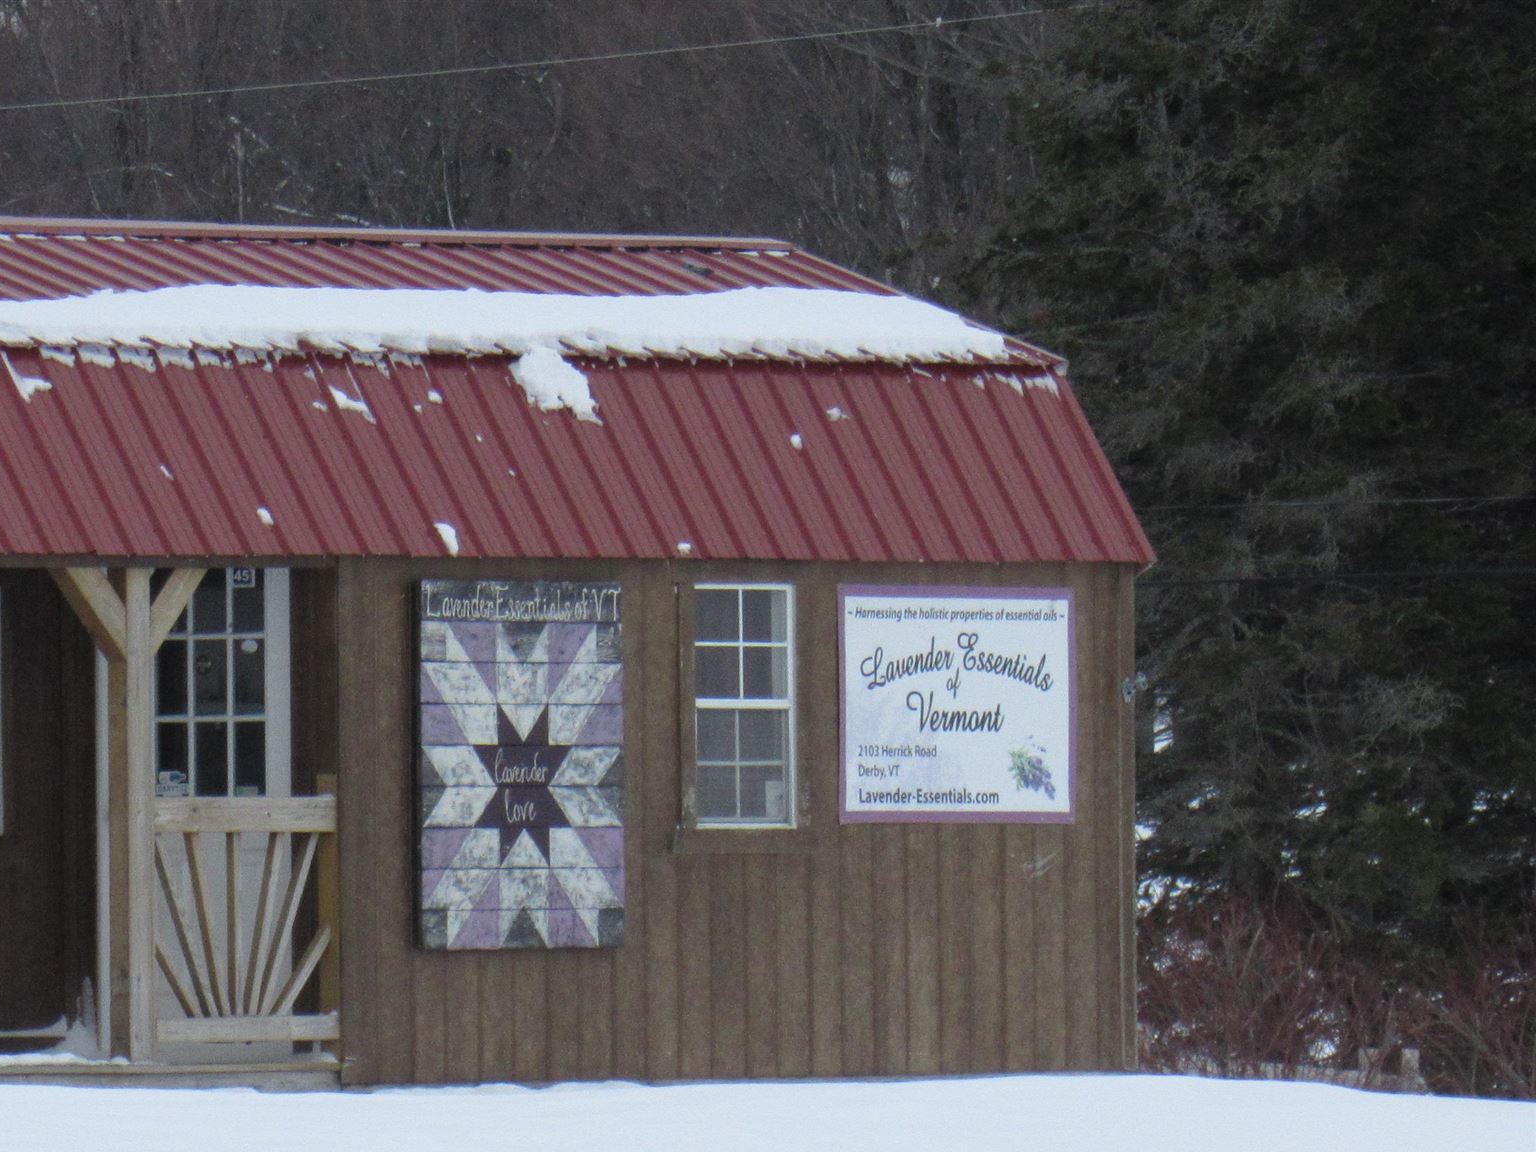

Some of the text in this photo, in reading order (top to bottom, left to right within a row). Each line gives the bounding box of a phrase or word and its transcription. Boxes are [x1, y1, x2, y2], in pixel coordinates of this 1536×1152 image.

[234, 569, 249, 582] 45
[424, 584, 493, 618] Lavender
[495, 585, 570, 620] Essentials
[574, 588, 588, 620] of
[855, 607, 1058, 622] Harnessing the holistic properties of essential oils
[860, 632, 1054, 692] Lavender Essentials
[946, 667, 961, 699] of
[906, 691, 1005, 734] Vermont
[858, 745, 937, 757] 2103 Herrick Road
[858, 764, 900, 779] Derby, VT
[858, 787, 1000, 804] Lavender-Essentials.com
